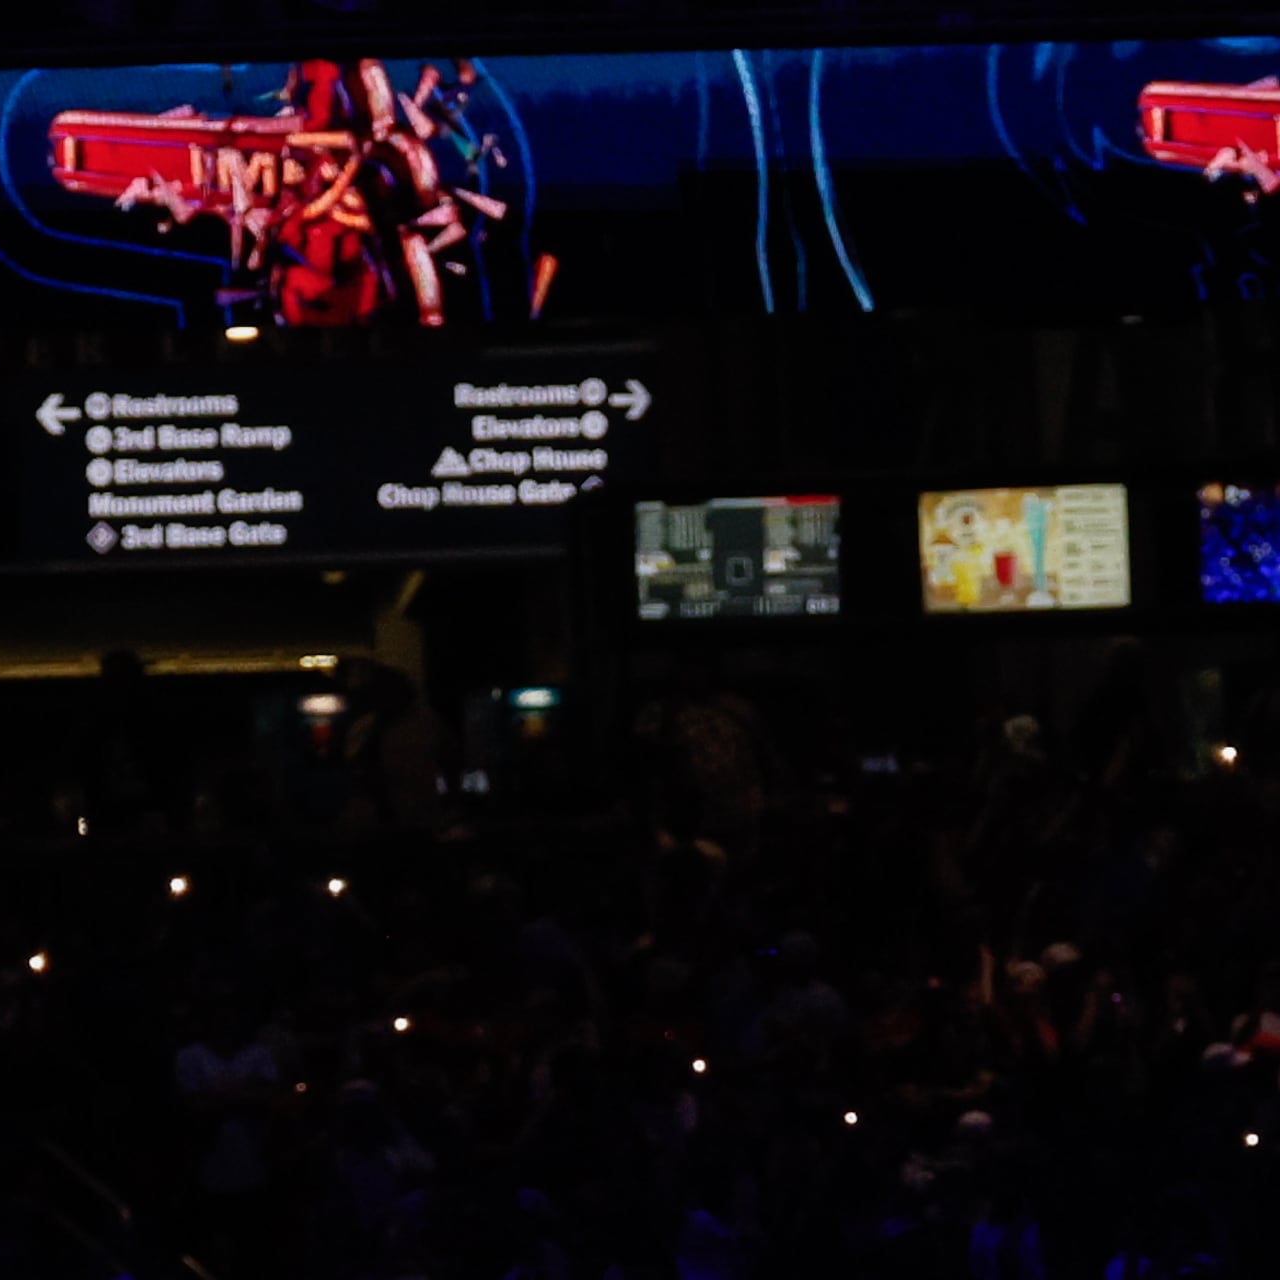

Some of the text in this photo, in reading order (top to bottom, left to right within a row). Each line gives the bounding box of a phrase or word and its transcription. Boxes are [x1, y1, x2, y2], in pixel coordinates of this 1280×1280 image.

[112, 394, 239, 418] Restrooms
[454, 383, 578, 407] Restrooms
[113, 423, 292, 451] 3rd Base Ramp
[471, 414, 579, 440] Elevators
[114, 458, 224, 484] Elevators
[470, 446, 607, 474] Chop House
[88, 488, 303, 517] Monument Garden
[377, 483, 440, 511] Chop
[442, 481, 516, 504] House
[121, 521, 287, 550] 3rd Base Gate
